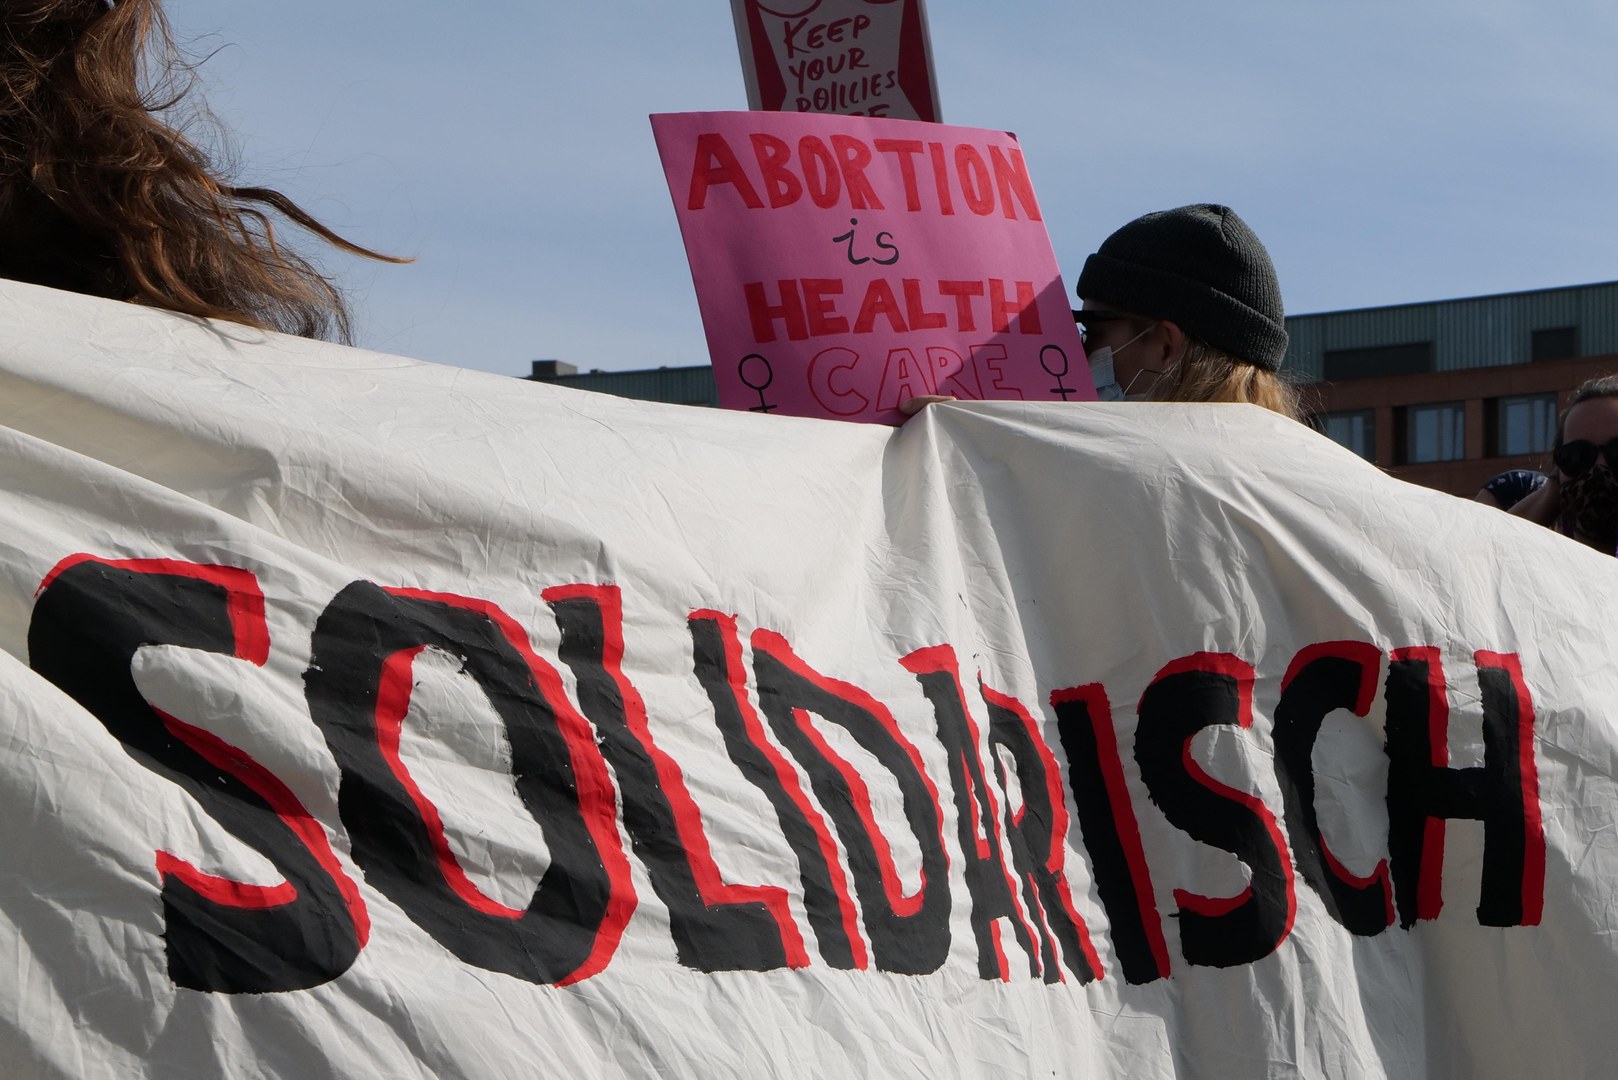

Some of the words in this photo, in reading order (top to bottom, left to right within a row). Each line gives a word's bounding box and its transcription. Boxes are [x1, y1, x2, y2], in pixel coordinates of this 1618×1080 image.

[783, 15, 871, 59] KEEP
[788, 47, 870, 94] YOUR
[687, 133, 1042, 222] ABORTION
[833, 218, 900, 266] is
[743, 278, 1042, 344] HEALTH
[807, 344, 1023, 416] CARE
[28, 551, 1545, 994] SOLIDARISCH
